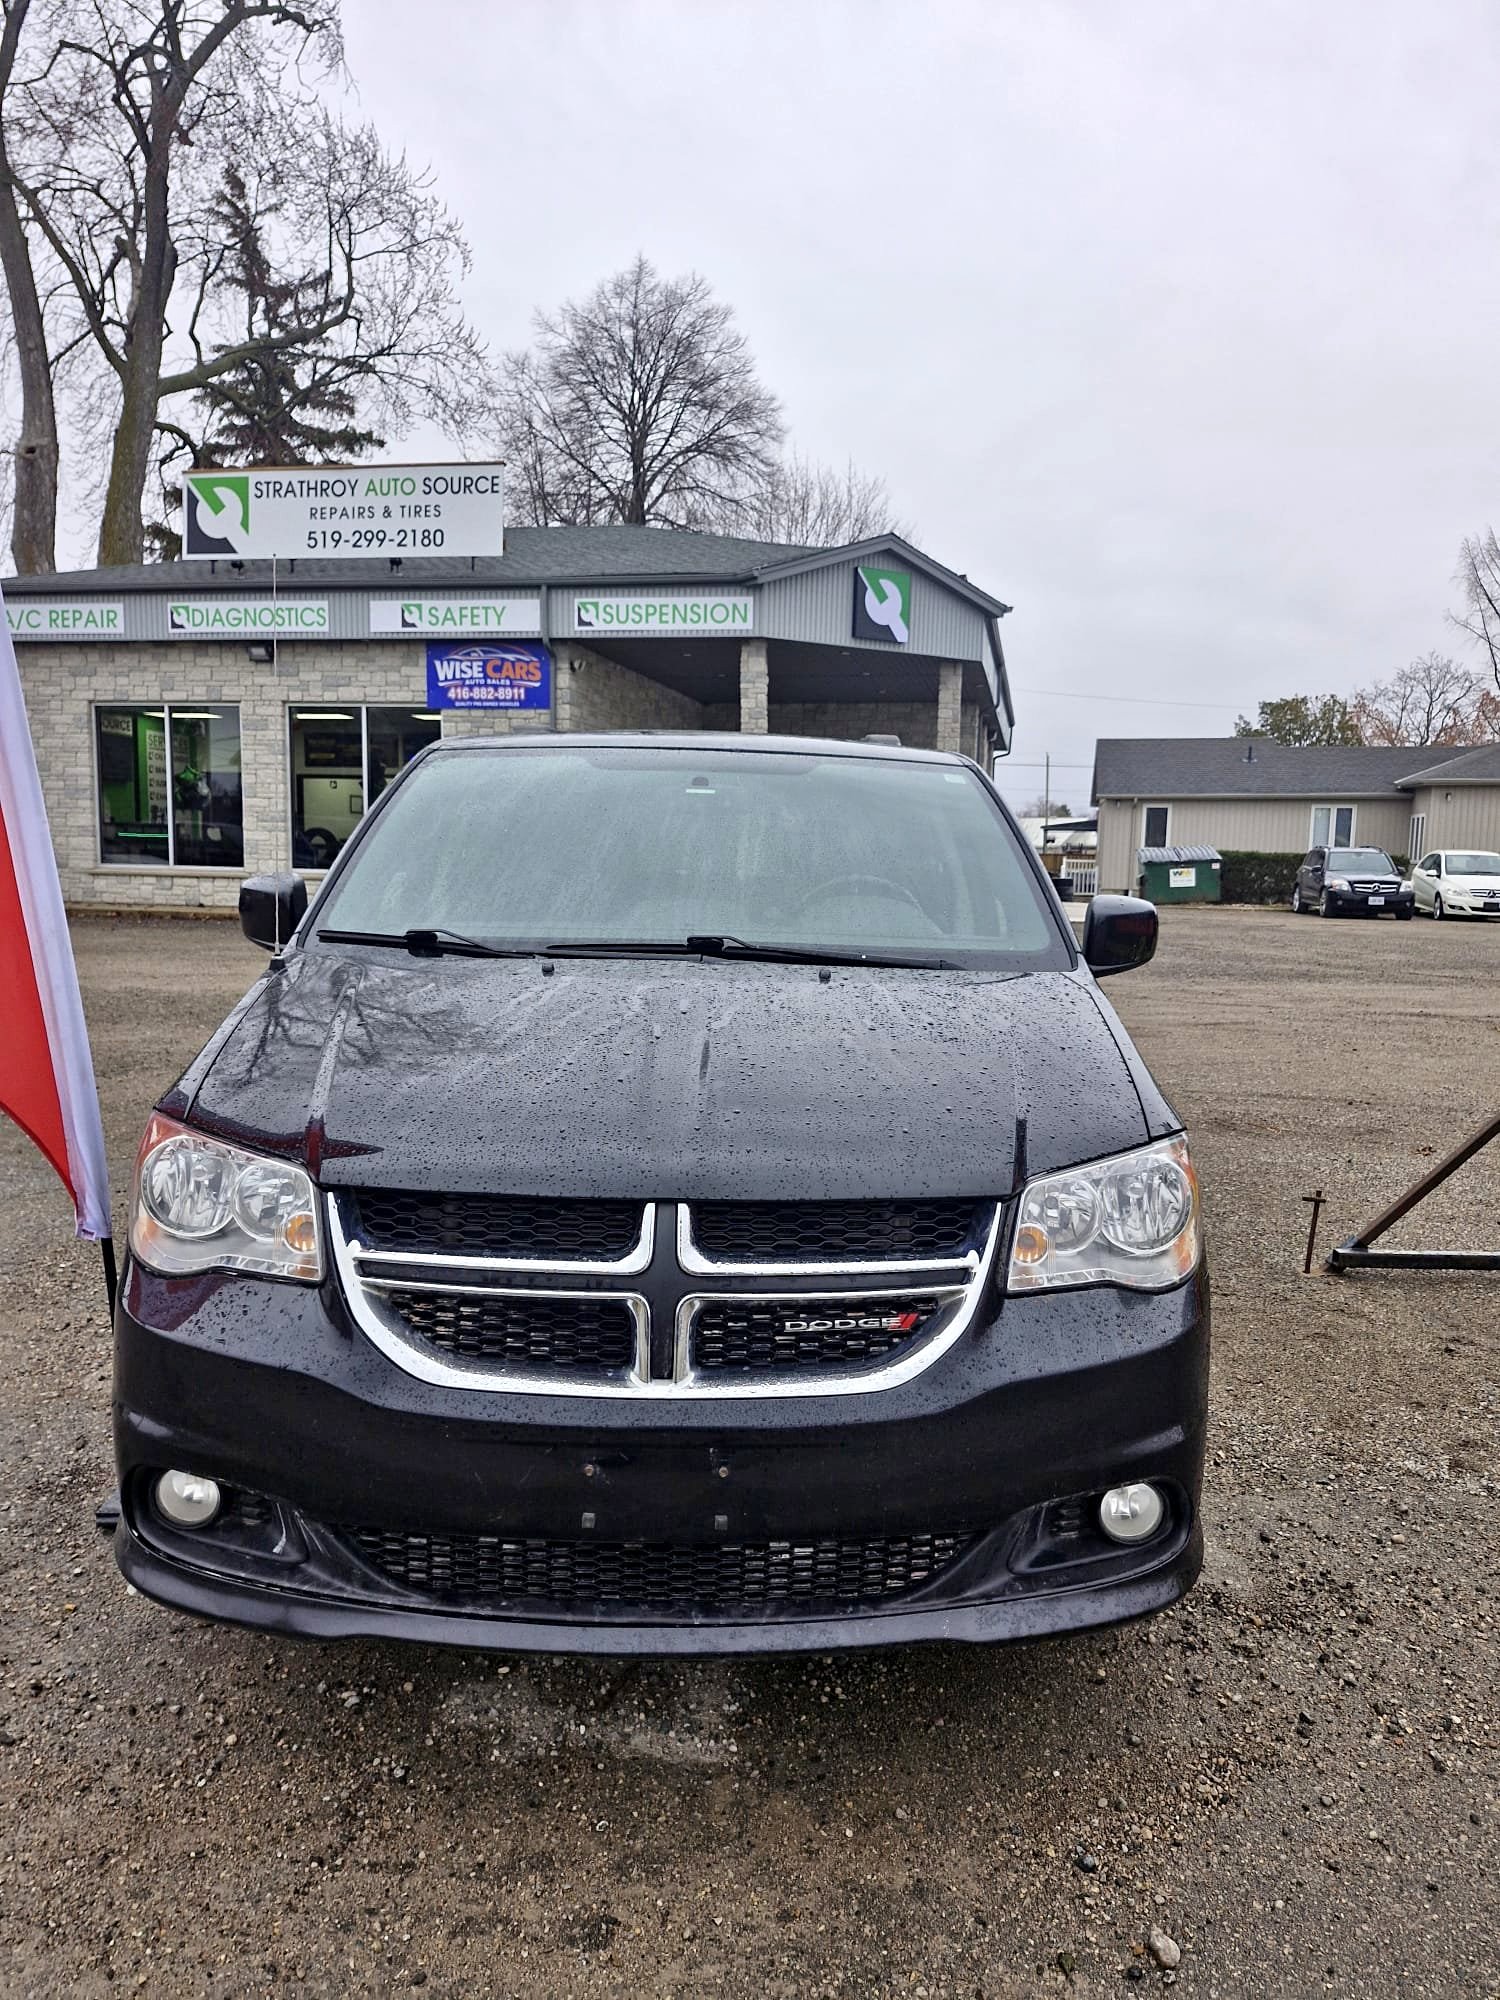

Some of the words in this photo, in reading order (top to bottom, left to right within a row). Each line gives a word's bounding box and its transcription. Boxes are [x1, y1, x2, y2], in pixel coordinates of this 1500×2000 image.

[253, 479, 358, 499] STRATHROY
[364, 477, 416, 497] AUTO
[422, 475, 500, 495] SOURCE
[309, 505, 375, 521] REPAIRS
[382, 504, 392, 519] &
[400, 504, 442, 518] TIRES
[306, 528, 445, 549] 519-299-2180
[49, 609, 118, 629] REPAIR
[191, 606, 327, 628] DIAGNOSTICS
[427, 606, 506, 626] SAFETY
[602, 602, 748, 625] SUSPENSION
[434, 659, 484, 681] WISE
[486, 659, 542, 681] CARS
[447, 686, 525, 700] 416-882-8911
[785, 1317, 902, 1332] DODGE
